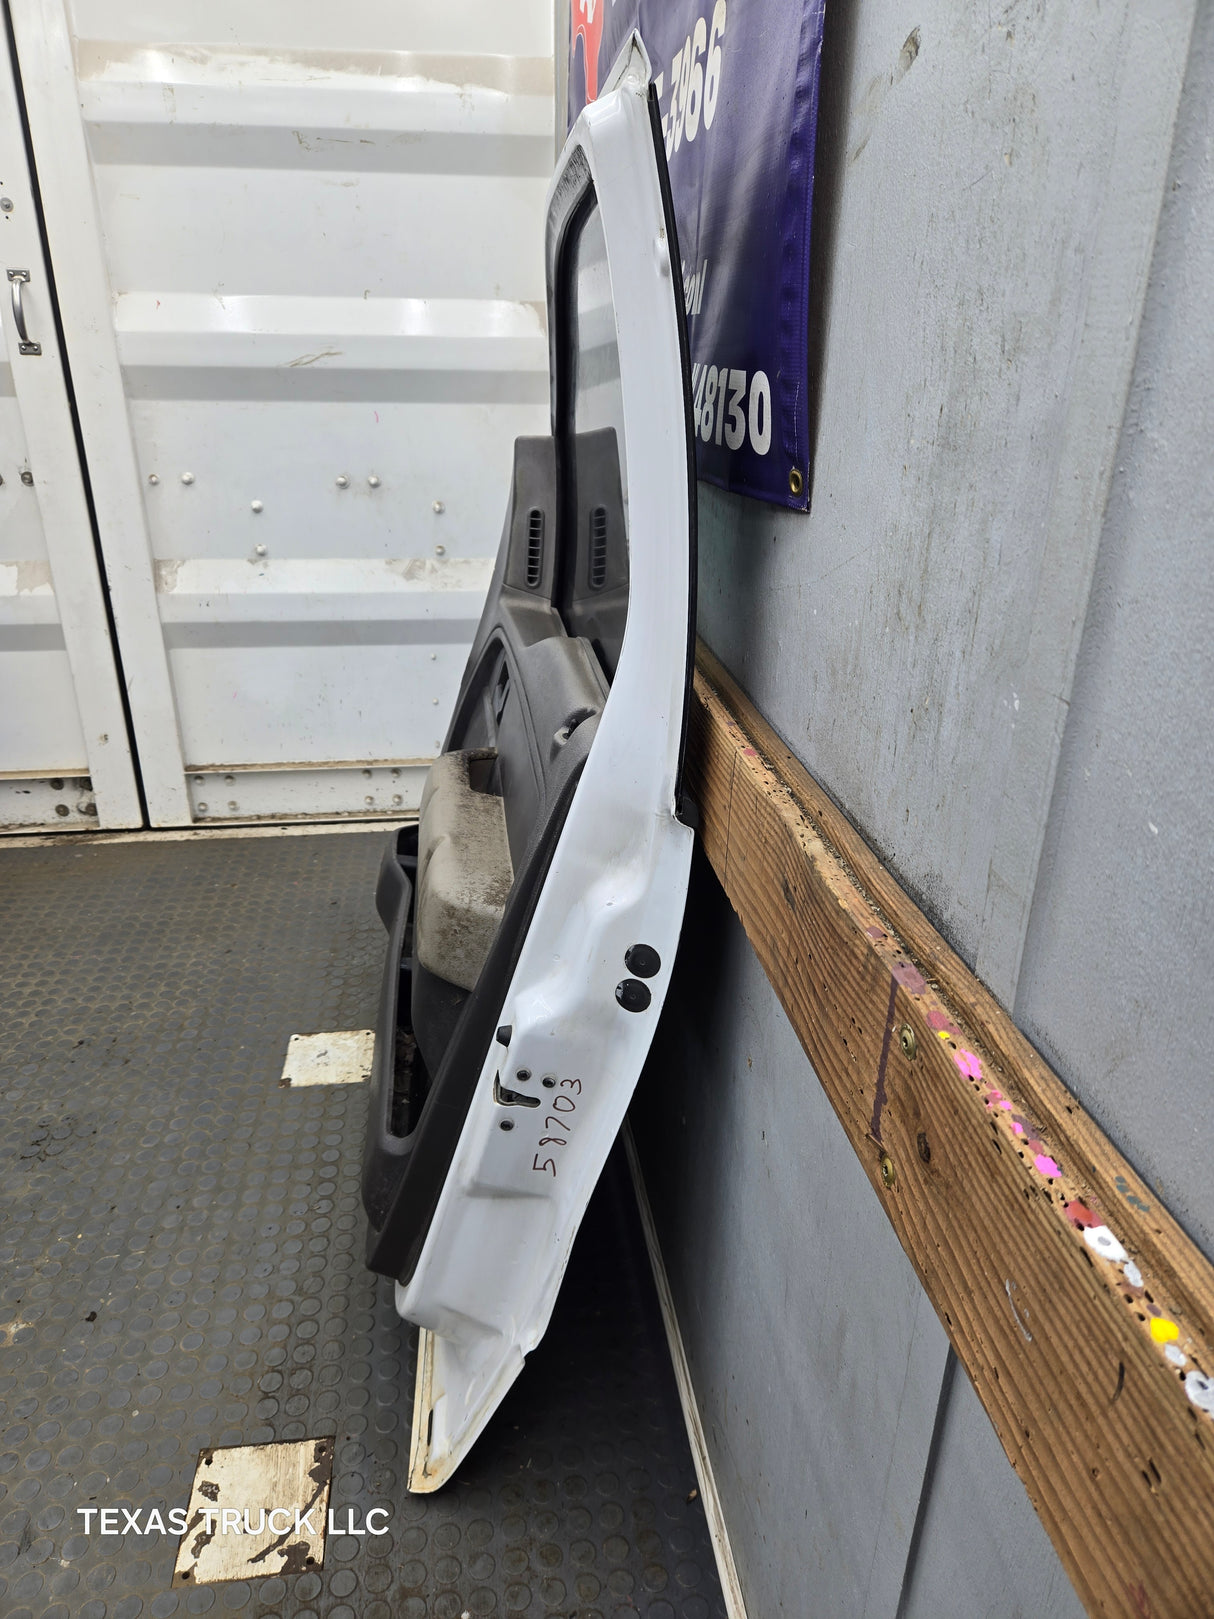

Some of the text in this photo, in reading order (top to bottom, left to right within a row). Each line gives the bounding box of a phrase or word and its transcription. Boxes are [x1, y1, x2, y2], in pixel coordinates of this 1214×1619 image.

[654, 0, 727, 162] -3966
[693, 364, 772, 456] 48130
[532, 1078, 582, 1177] 58703
